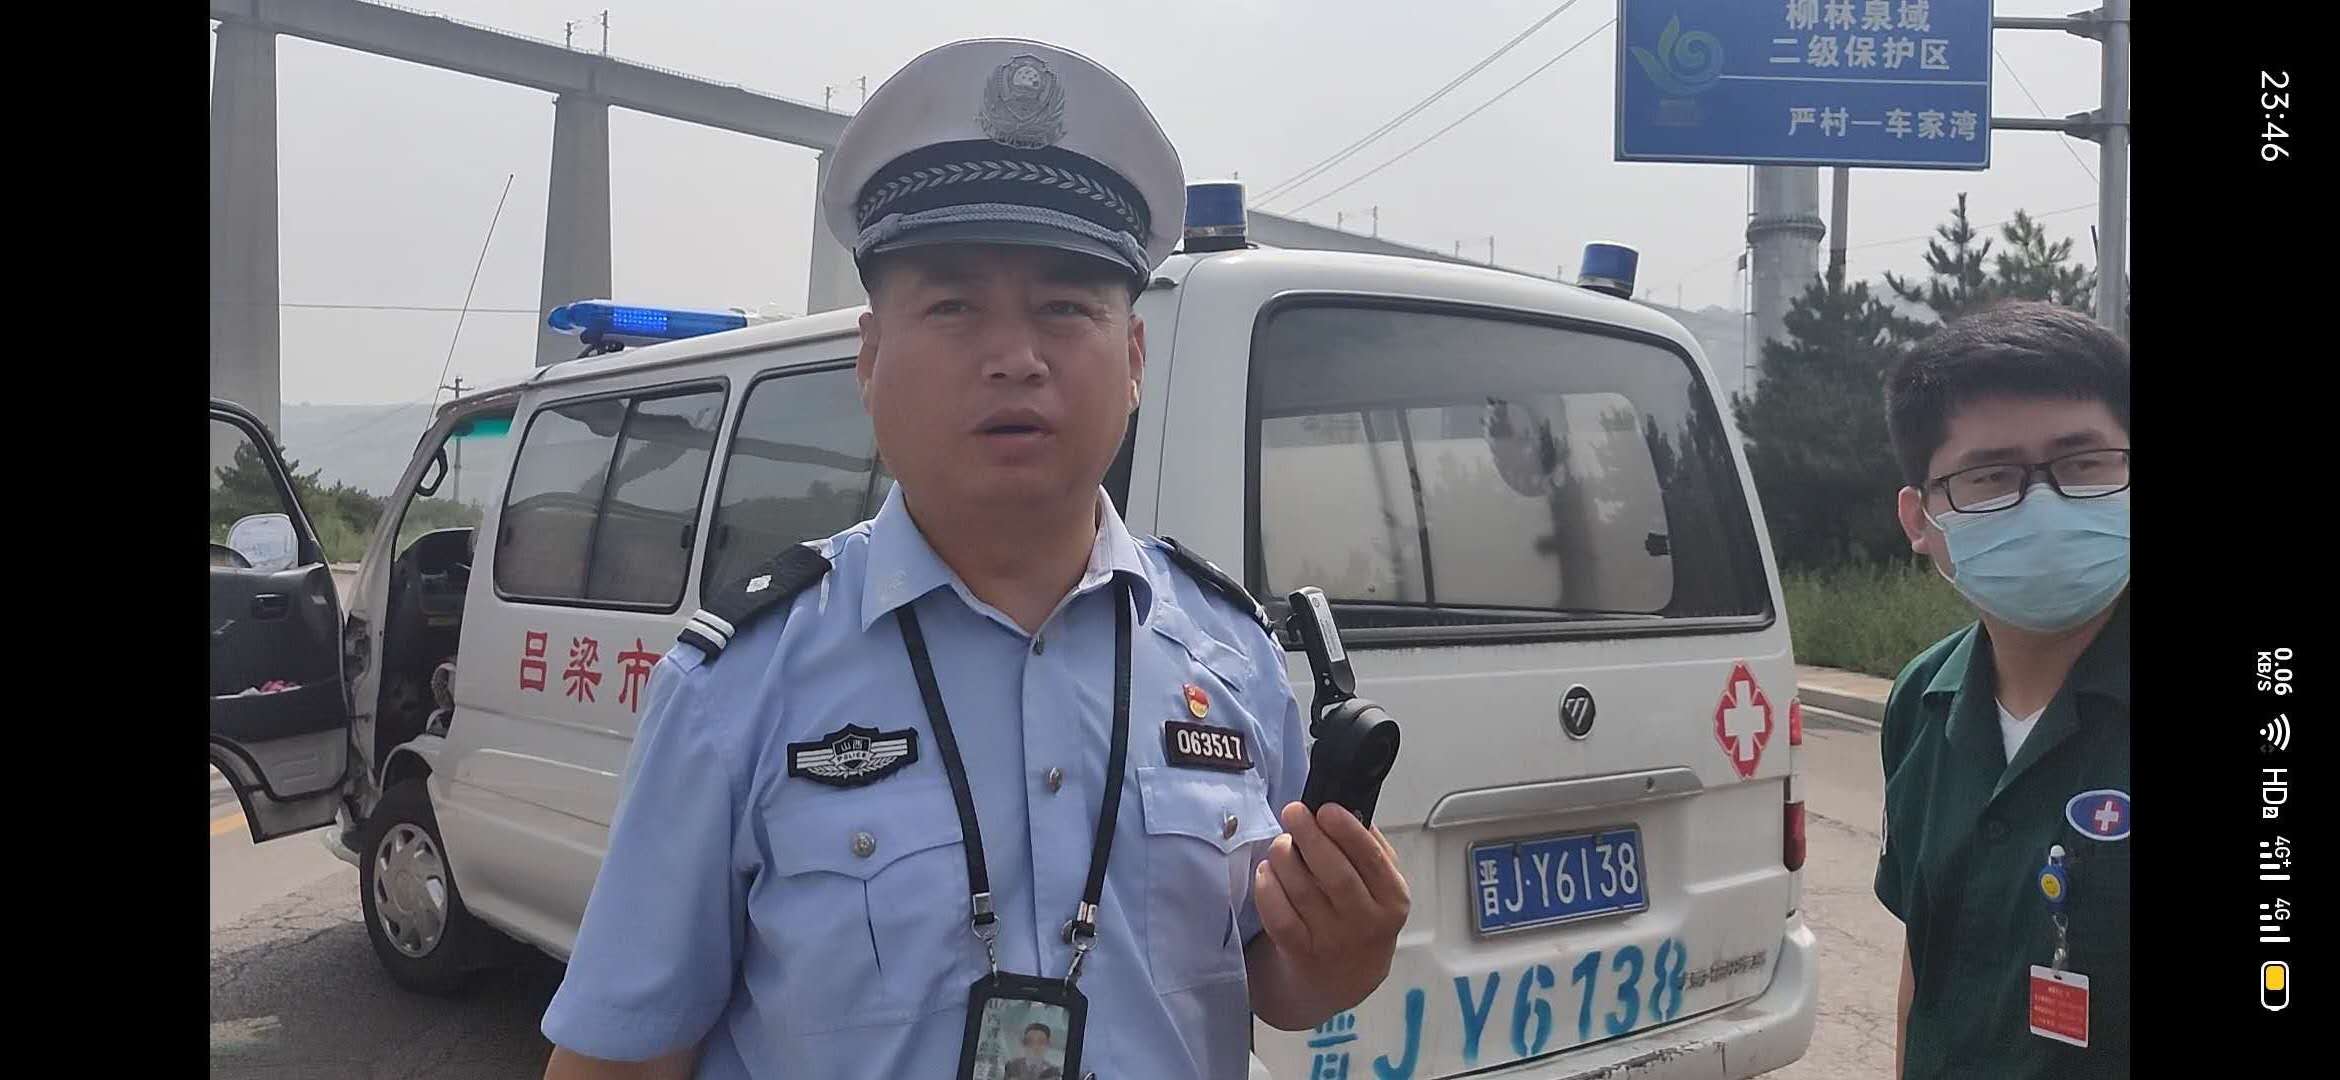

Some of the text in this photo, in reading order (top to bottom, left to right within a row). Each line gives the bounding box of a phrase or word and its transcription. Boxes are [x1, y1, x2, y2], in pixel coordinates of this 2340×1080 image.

[1785, 0, 1931, 32] 柳林泉域
[1769, 34, 1950, 70] 二级保护区
[519, 630, 664, 713] 吕梁市
[1177, 729, 1242, 760] 063517
